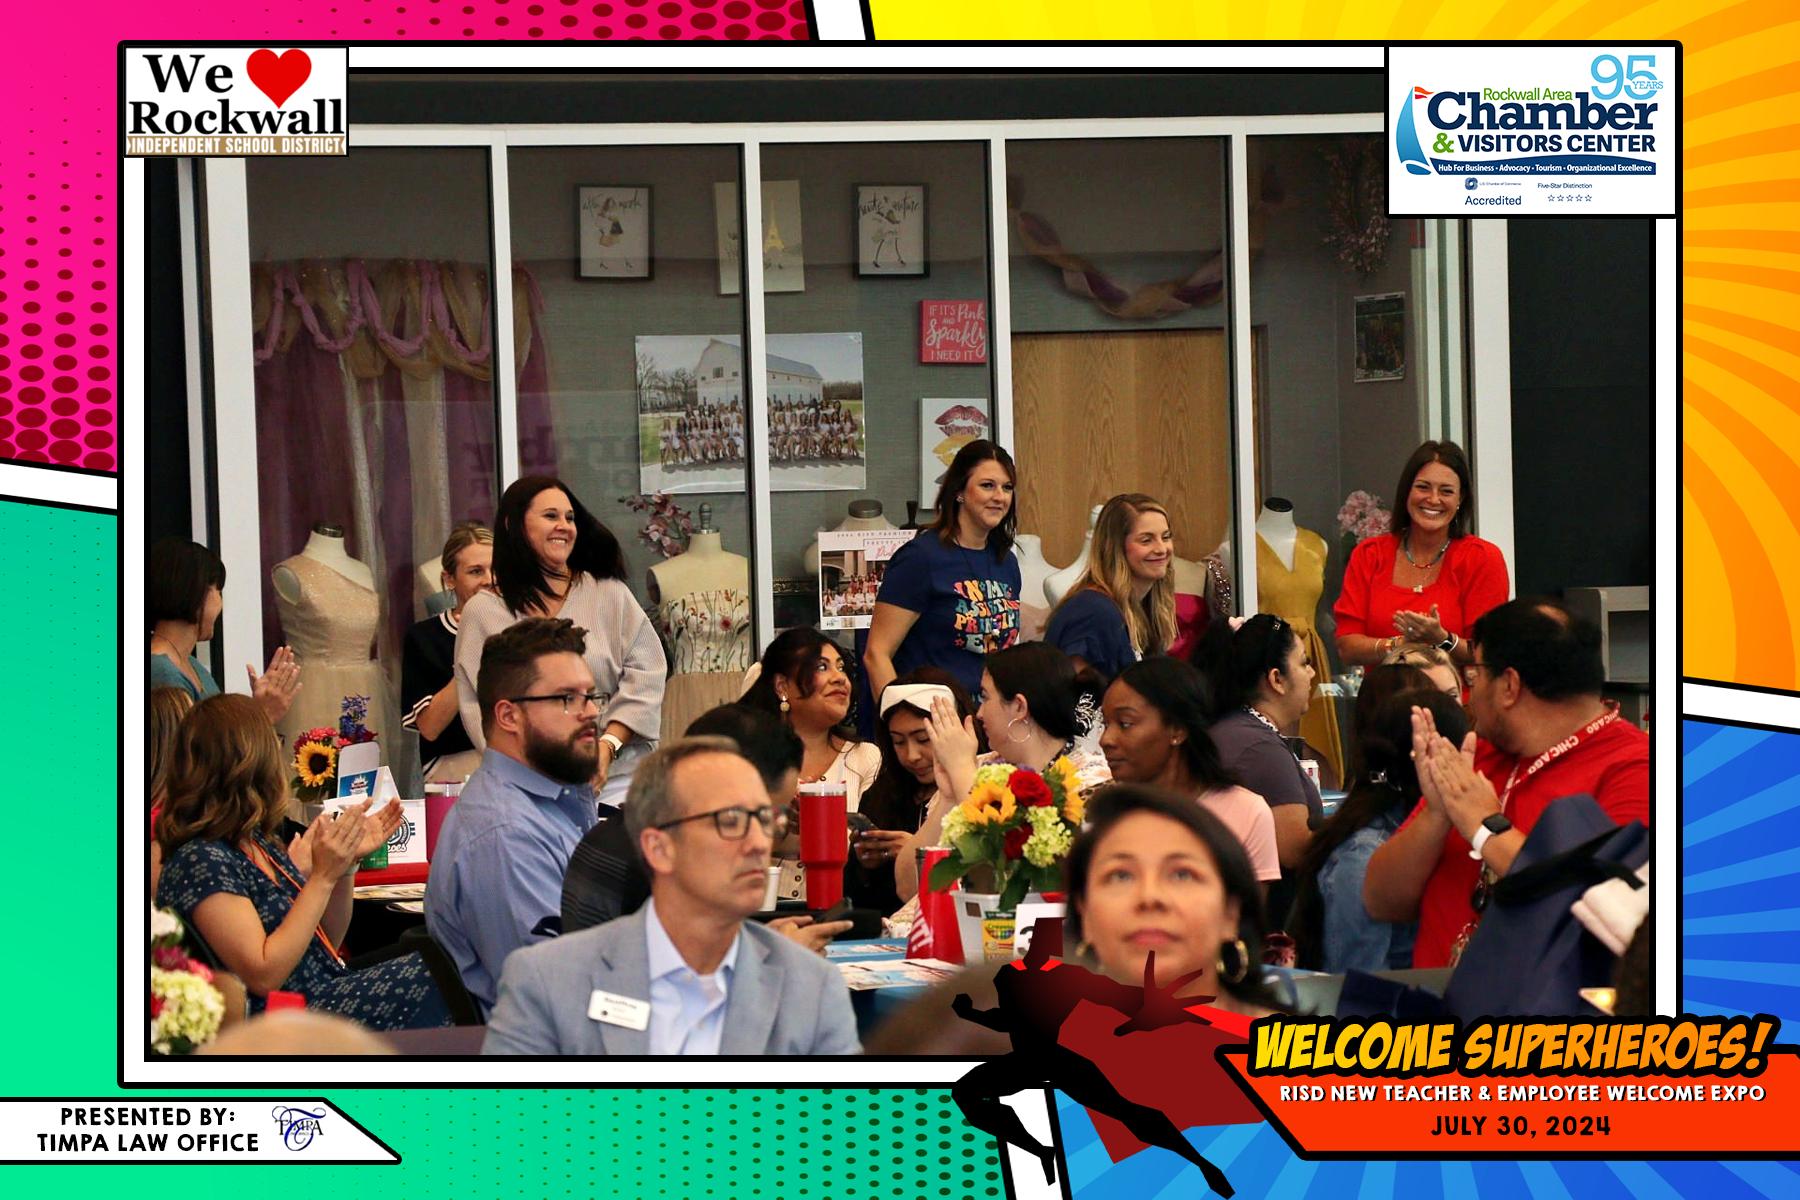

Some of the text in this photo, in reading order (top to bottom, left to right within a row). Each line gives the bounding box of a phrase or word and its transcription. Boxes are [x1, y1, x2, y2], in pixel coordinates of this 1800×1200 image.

[929, 304, 938, 317] IF
[957, 303, 986, 322] Pink
[926, 318, 986, 358] Sparkly
[936, 350, 960, 361] NEED
[964, 350, 974, 361] IT
[953, 580, 1009, 602] IN MY
[1527, 735, 1580, 775] CHICAGO
